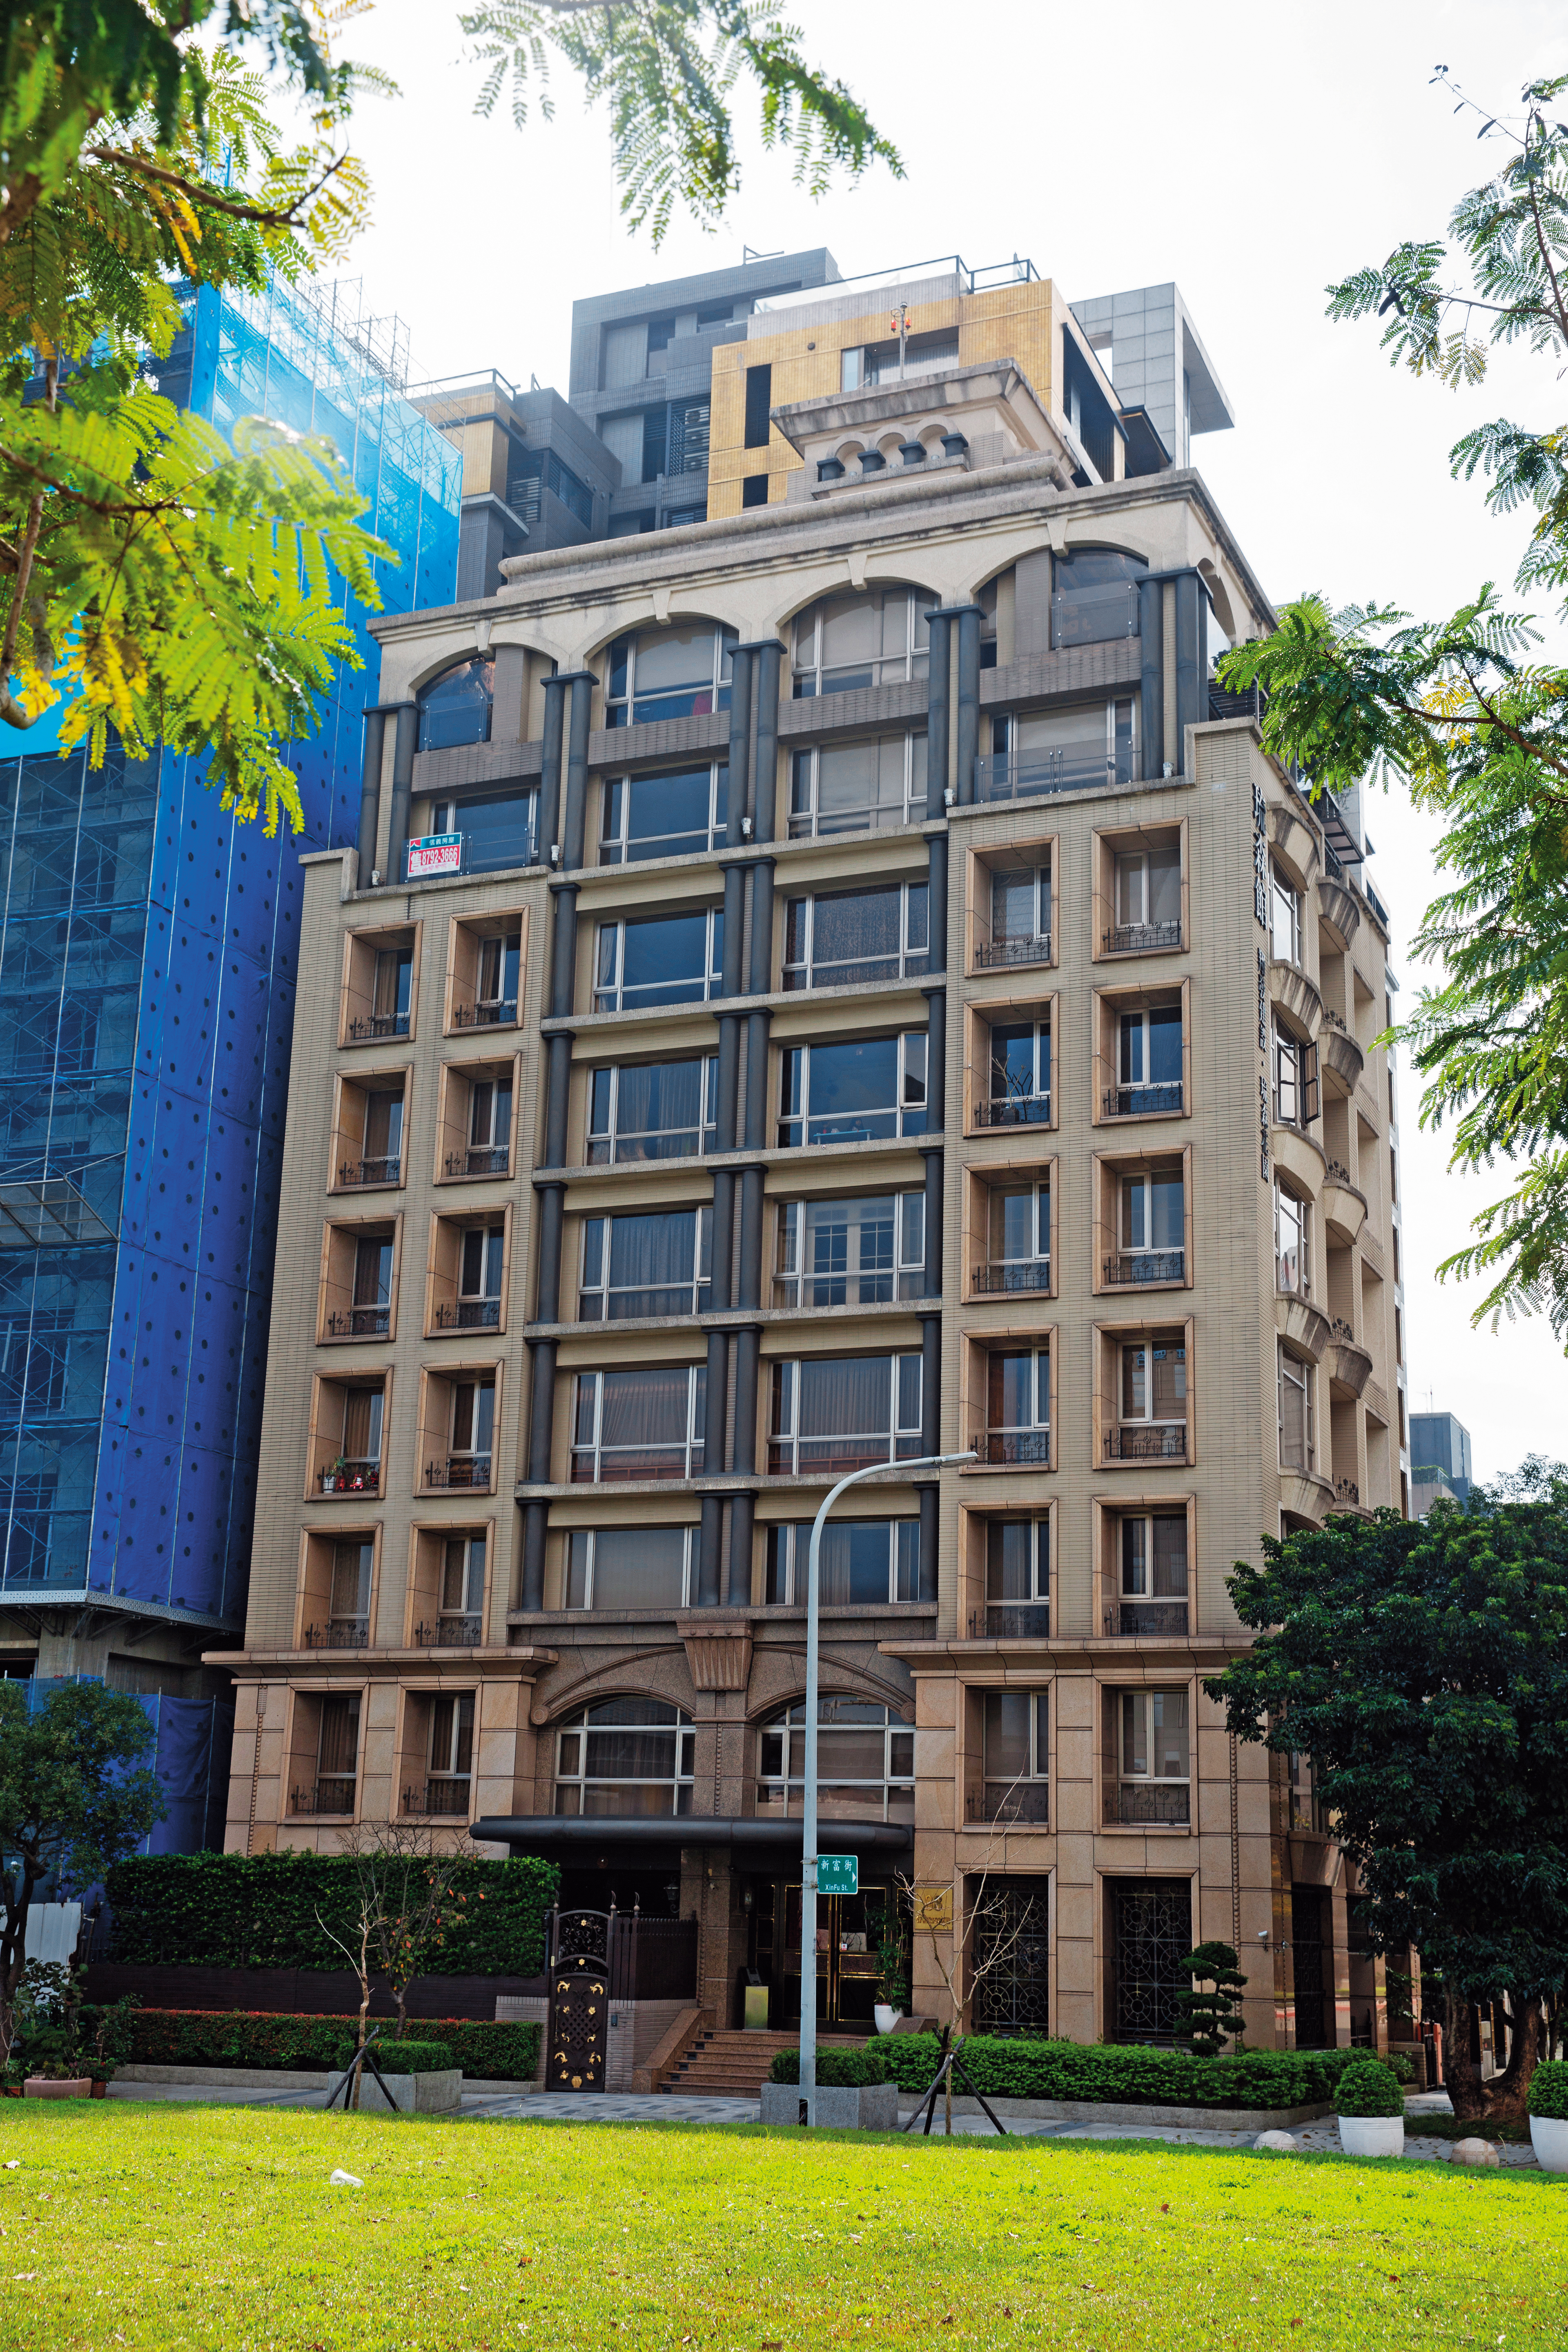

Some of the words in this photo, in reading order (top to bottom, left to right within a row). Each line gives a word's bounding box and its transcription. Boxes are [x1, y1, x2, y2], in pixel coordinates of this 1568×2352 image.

[429, 837, 454, 846] 信義房屋
[410, 852, 421, 871] 售
[1252, 783, 1267, 930] 琉森館
[821, 1859, 853, 1871] 新富街
